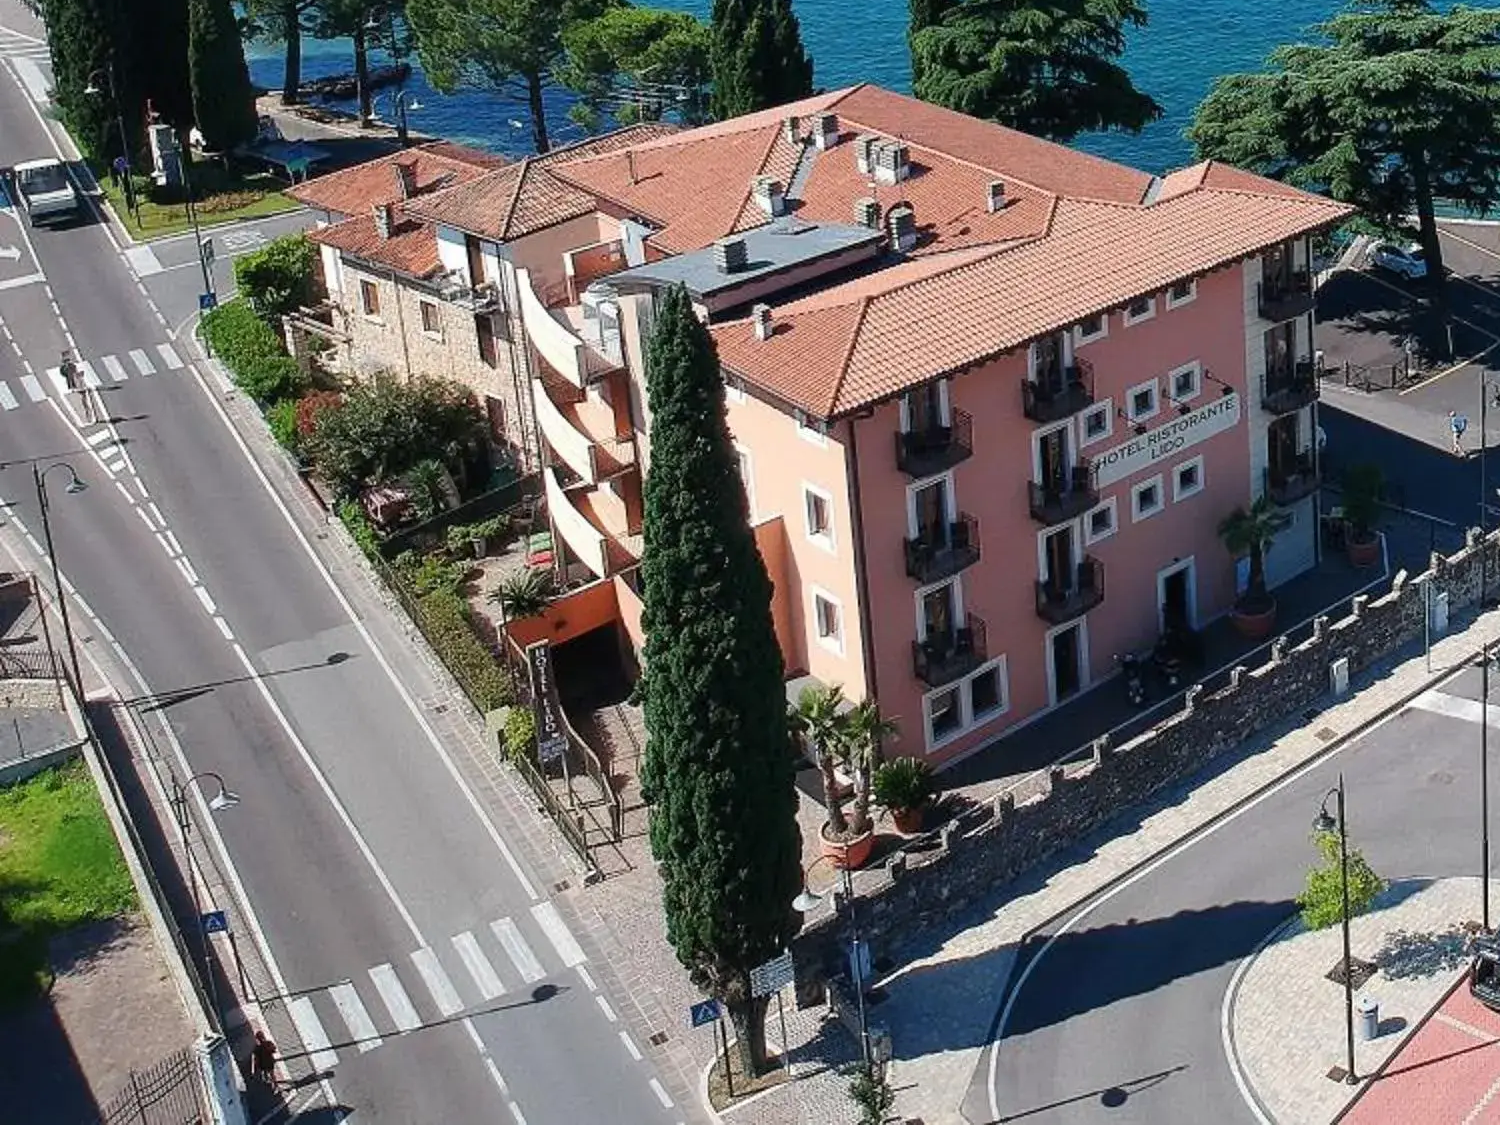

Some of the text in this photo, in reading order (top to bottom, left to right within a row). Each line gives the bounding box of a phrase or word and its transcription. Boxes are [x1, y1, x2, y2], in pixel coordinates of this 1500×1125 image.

[1097, 396, 1235, 470] HOTEL RISTORANTE
[1151, 436, 1185, 460] LIDO
[535, 648, 549, 693] HOTEL
[543, 698, 556, 732] LIDO
